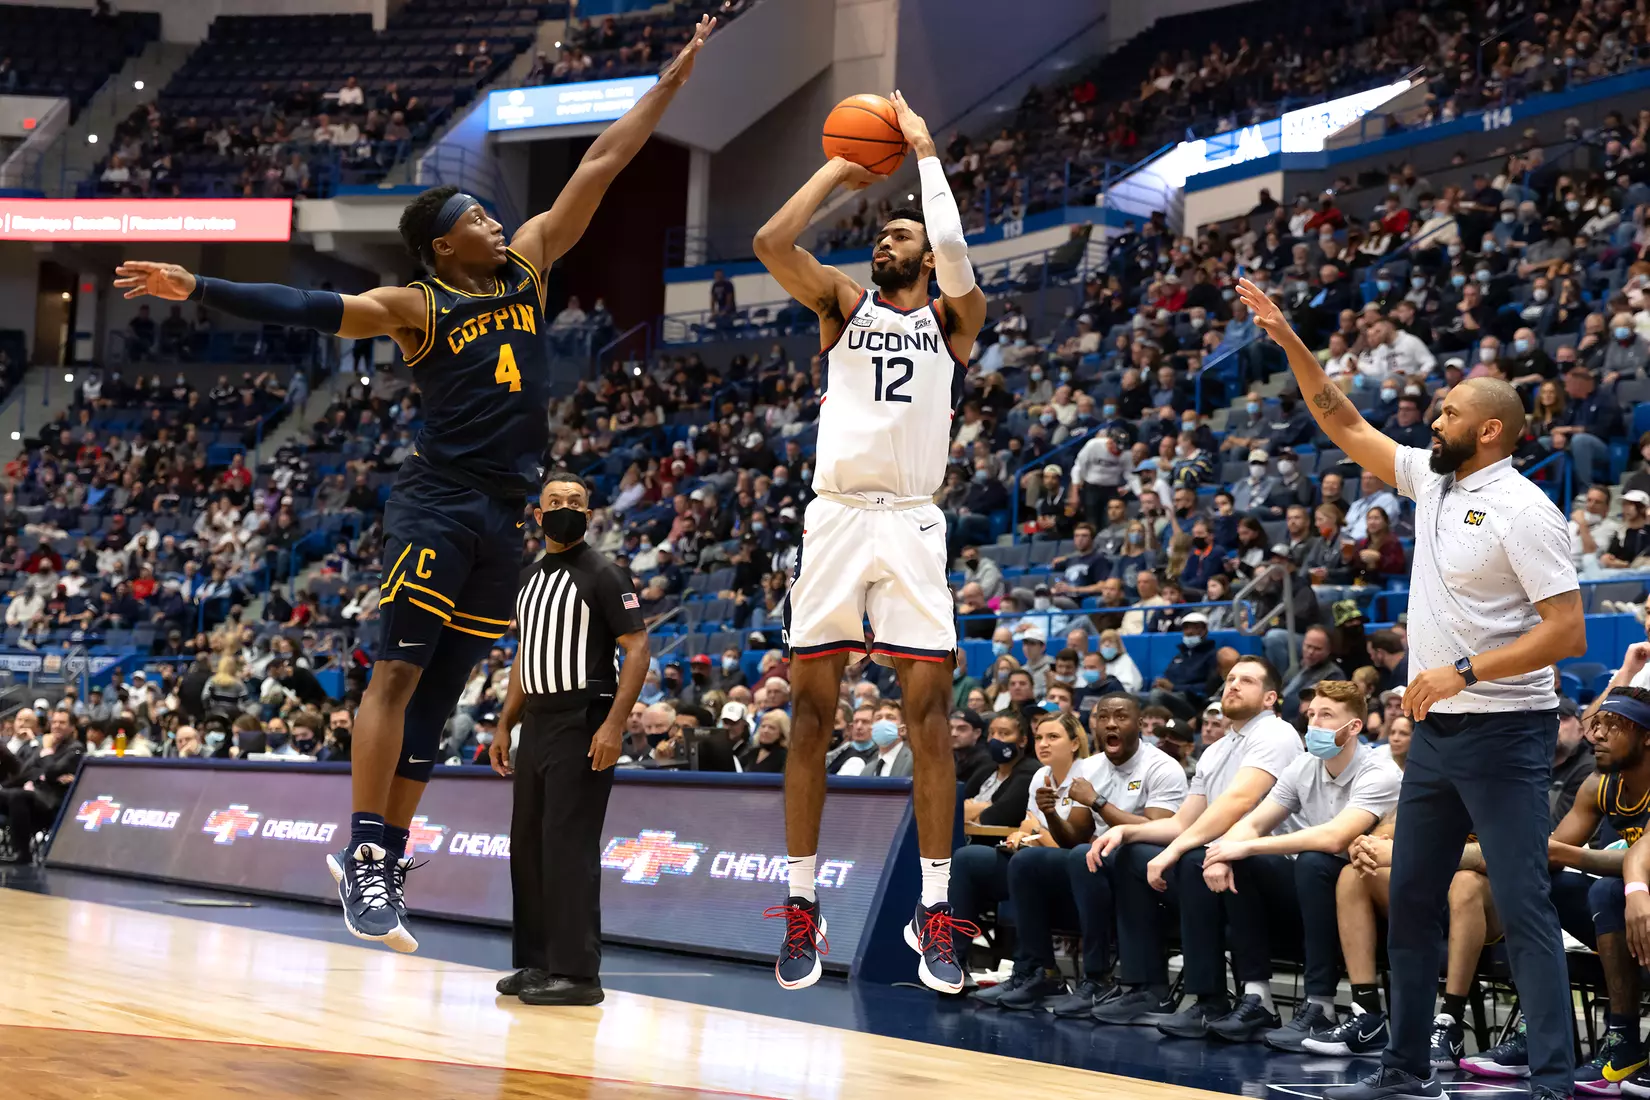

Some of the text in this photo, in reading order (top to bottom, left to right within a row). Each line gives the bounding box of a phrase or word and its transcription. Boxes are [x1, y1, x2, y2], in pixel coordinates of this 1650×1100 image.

[1482, 106, 1512, 131] 114
[447, 303, 537, 355] COPPIN
[848, 330, 938, 353] UCONN
[494, 343, 522, 393] 4
[871, 356, 914, 403] 12
[415, 547, 436, 579] C
[121, 808, 180, 828] CHEVROLET
[262, 819, 337, 842] CHEVROLET
